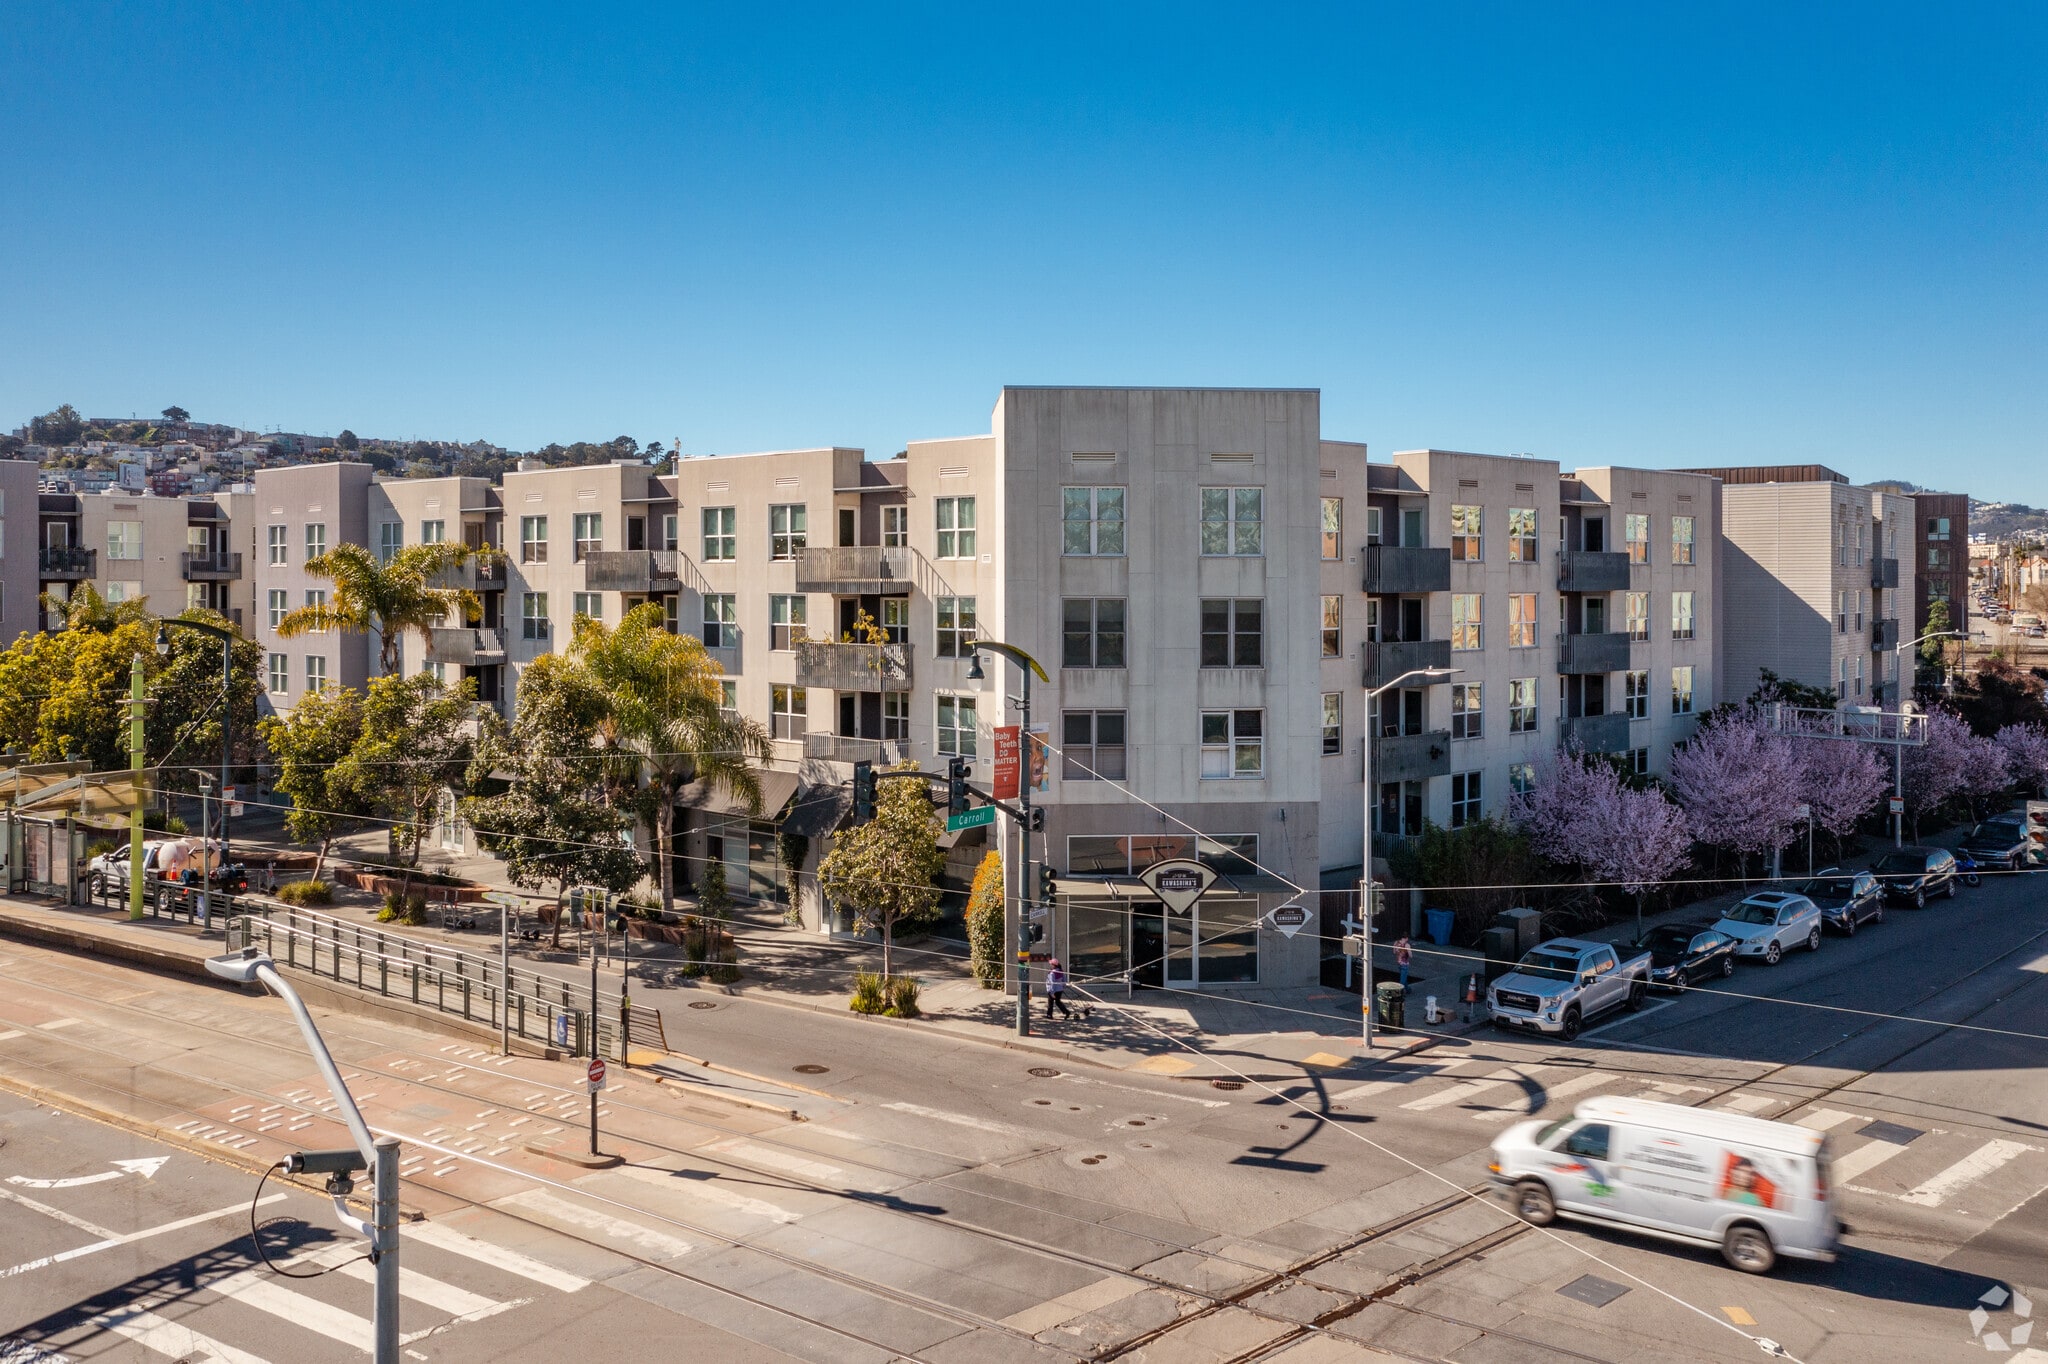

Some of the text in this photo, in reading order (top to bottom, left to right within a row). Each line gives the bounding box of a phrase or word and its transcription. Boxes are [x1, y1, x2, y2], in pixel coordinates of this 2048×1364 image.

[995, 732, 1010, 741] Baby
[1000, 740, 1017, 748] Teeth
[995, 757, 1018, 765] MATTER
[959, 812, 985, 825] Carroll
